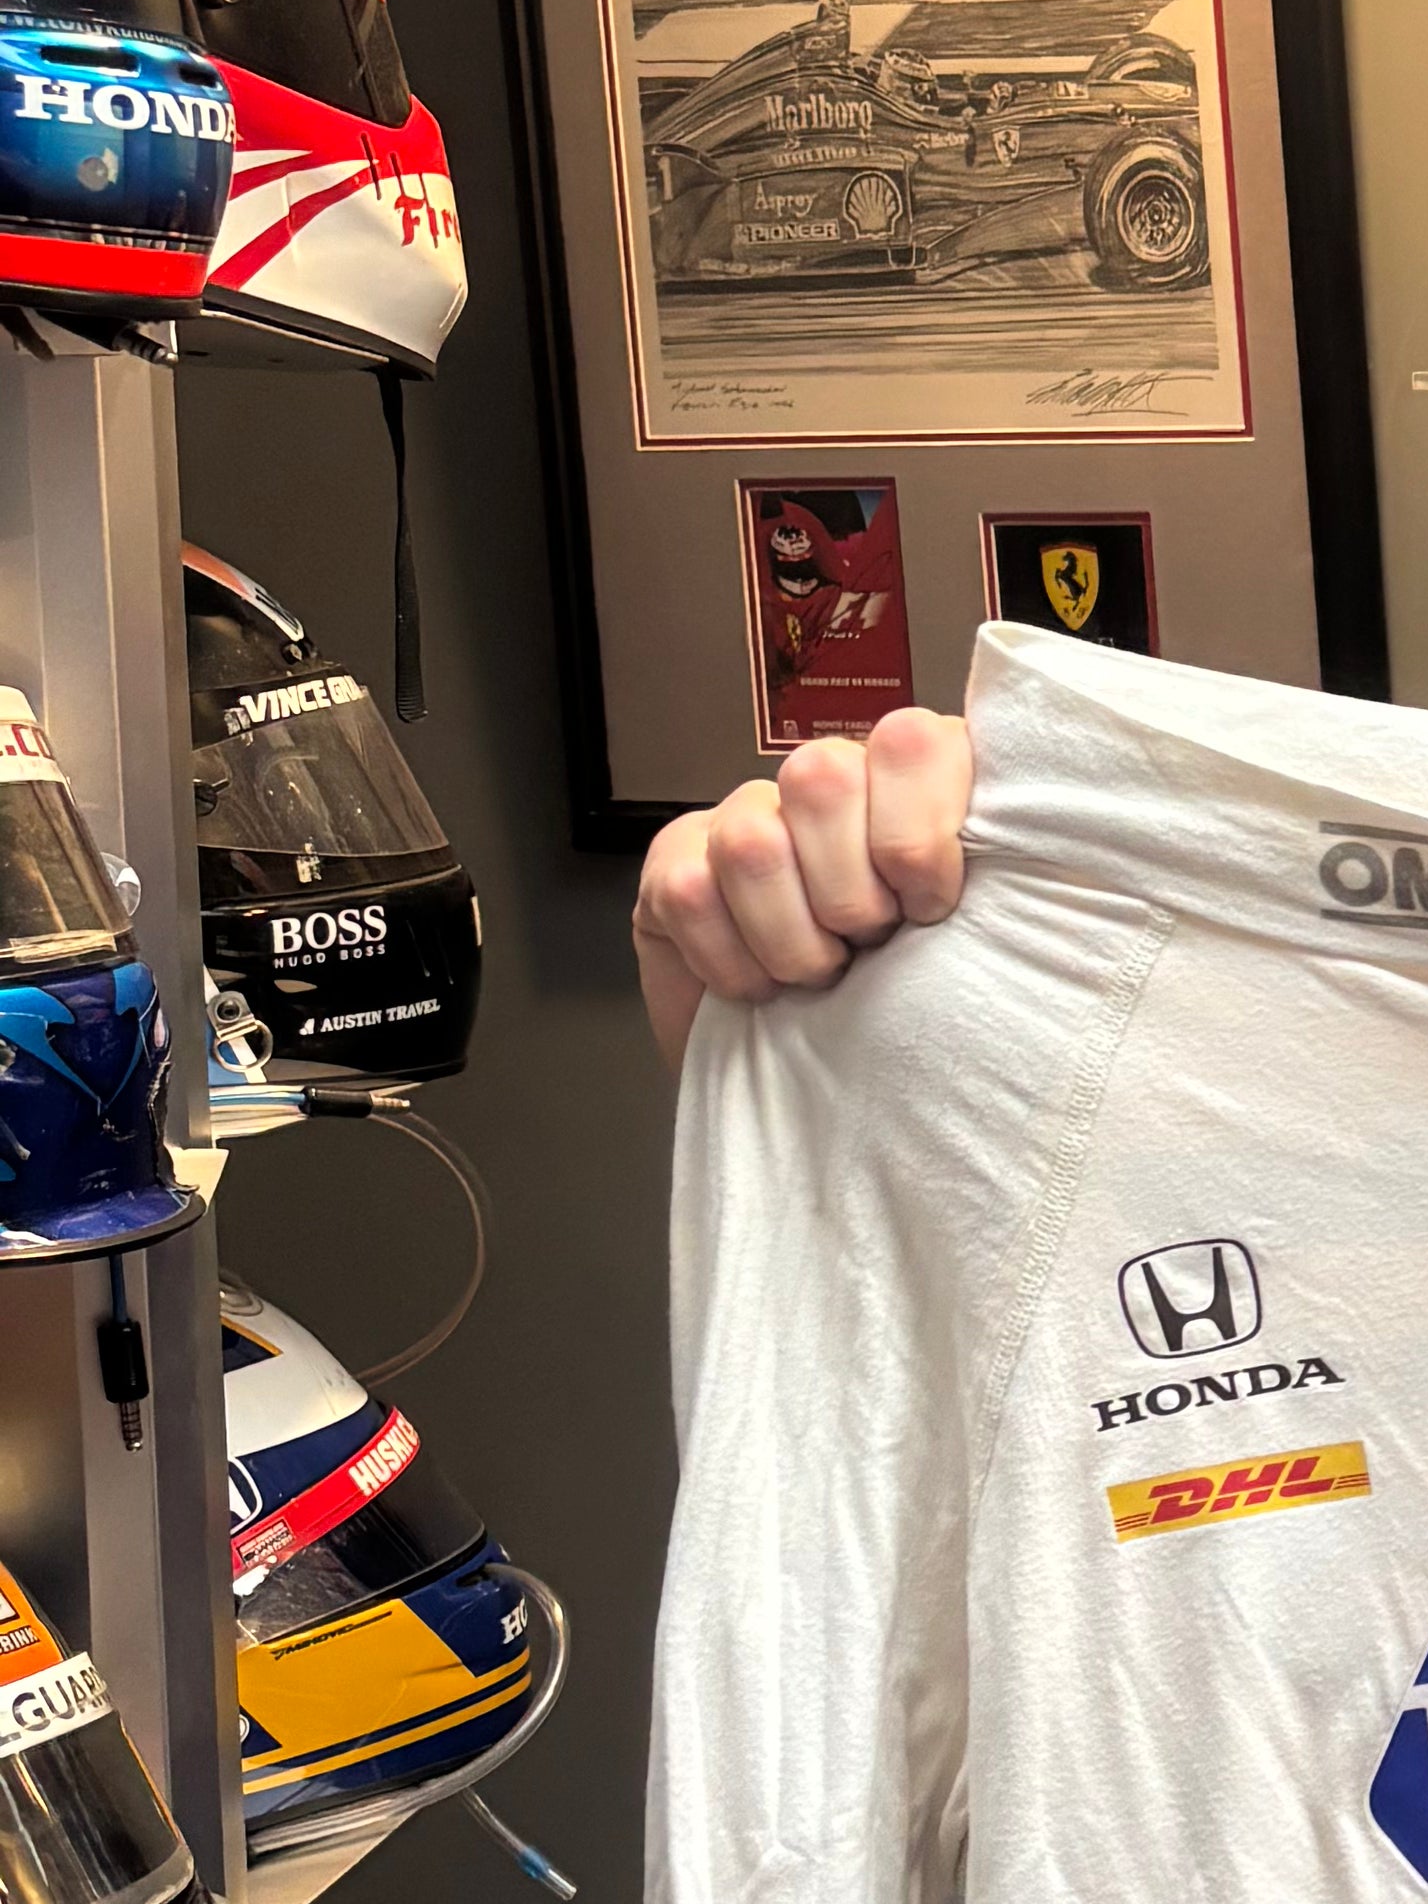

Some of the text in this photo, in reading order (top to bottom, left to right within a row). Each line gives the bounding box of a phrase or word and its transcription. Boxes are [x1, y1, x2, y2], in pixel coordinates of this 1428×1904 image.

[764, 93, 873, 132] Marlboro
[239, 679, 331, 724] VINCE
[271, 905, 388, 954] BOSS
[273, 943, 386, 969] HUGO BOSS
[320, 998, 441, 1033] AUSTIN TRAVEL
[1091, 1357, 1346, 1432] HONDA
[1148, 1456, 1336, 1525] DHL
[0, 1625, 40, 1657] RINK
